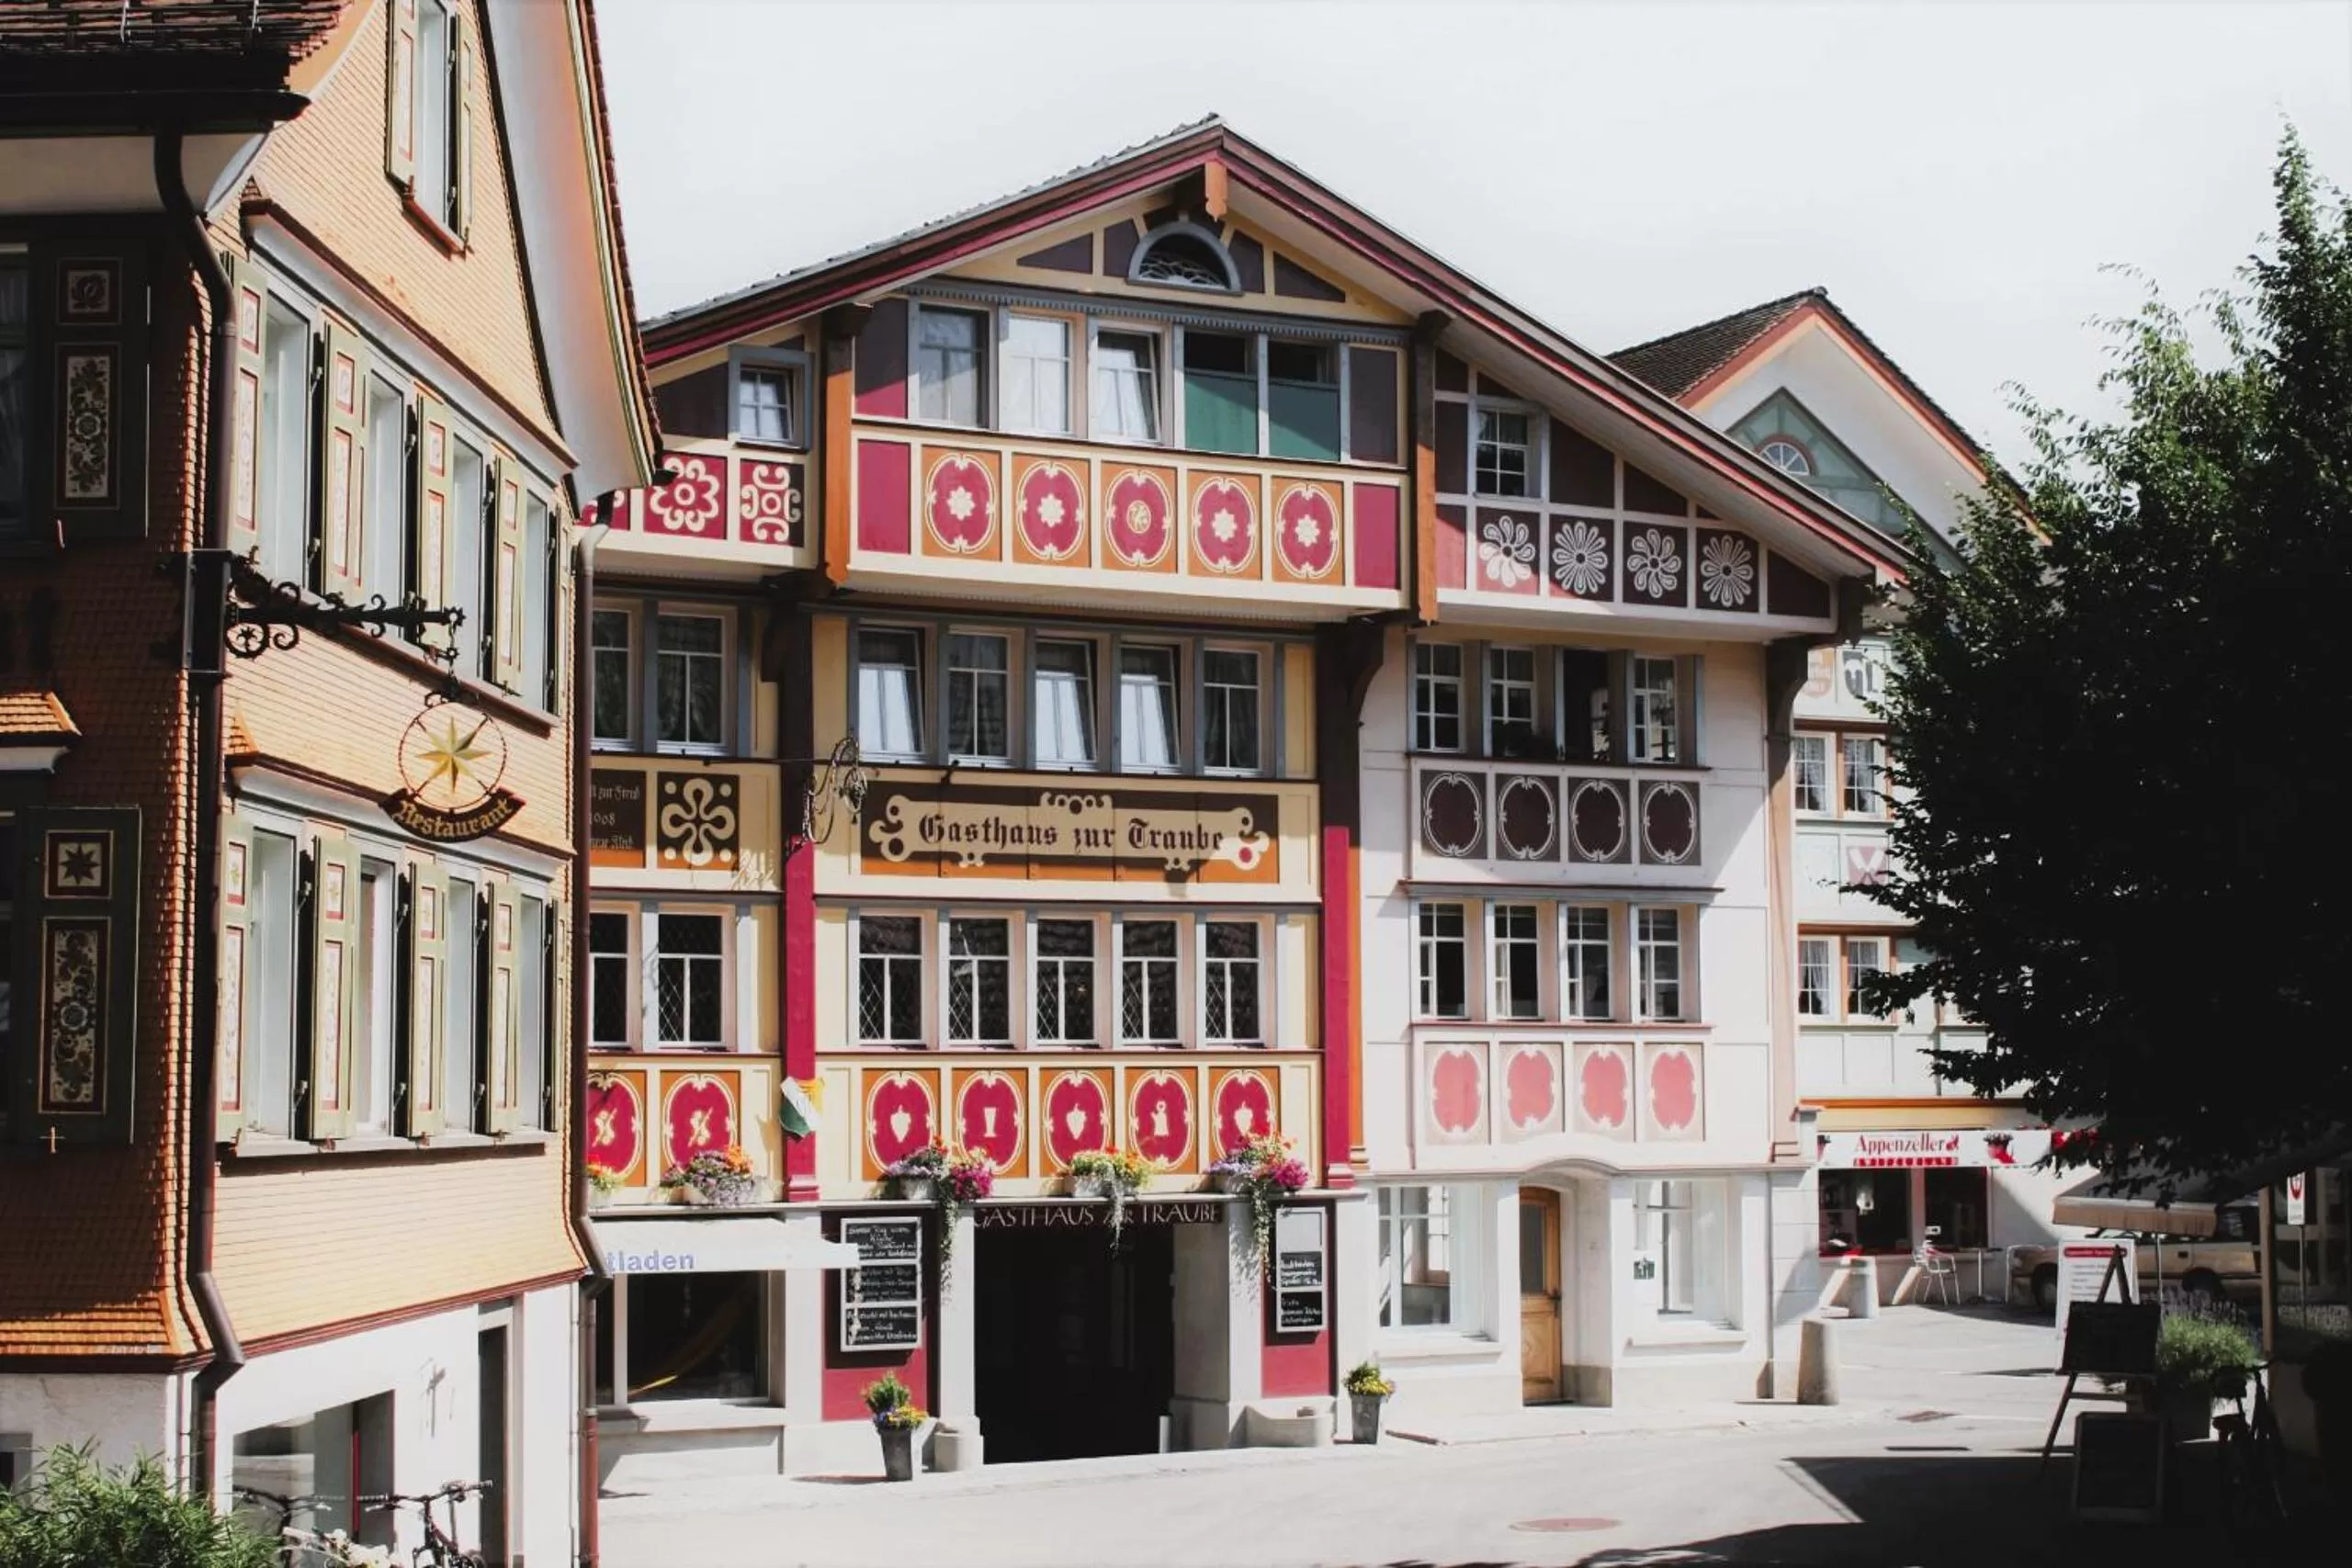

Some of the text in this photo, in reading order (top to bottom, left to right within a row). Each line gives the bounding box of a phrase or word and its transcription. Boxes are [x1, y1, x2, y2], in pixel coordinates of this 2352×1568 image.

[392, 798, 513, 837] Restaurant
[919, 814, 1224, 855] Gasthaus zur Traube
[1854, 1133, 1946, 1155] Appenzeller
[974, 1205, 1094, 1228] GASTHAUS
[1142, 1203, 1218, 1224] TRAUBE
